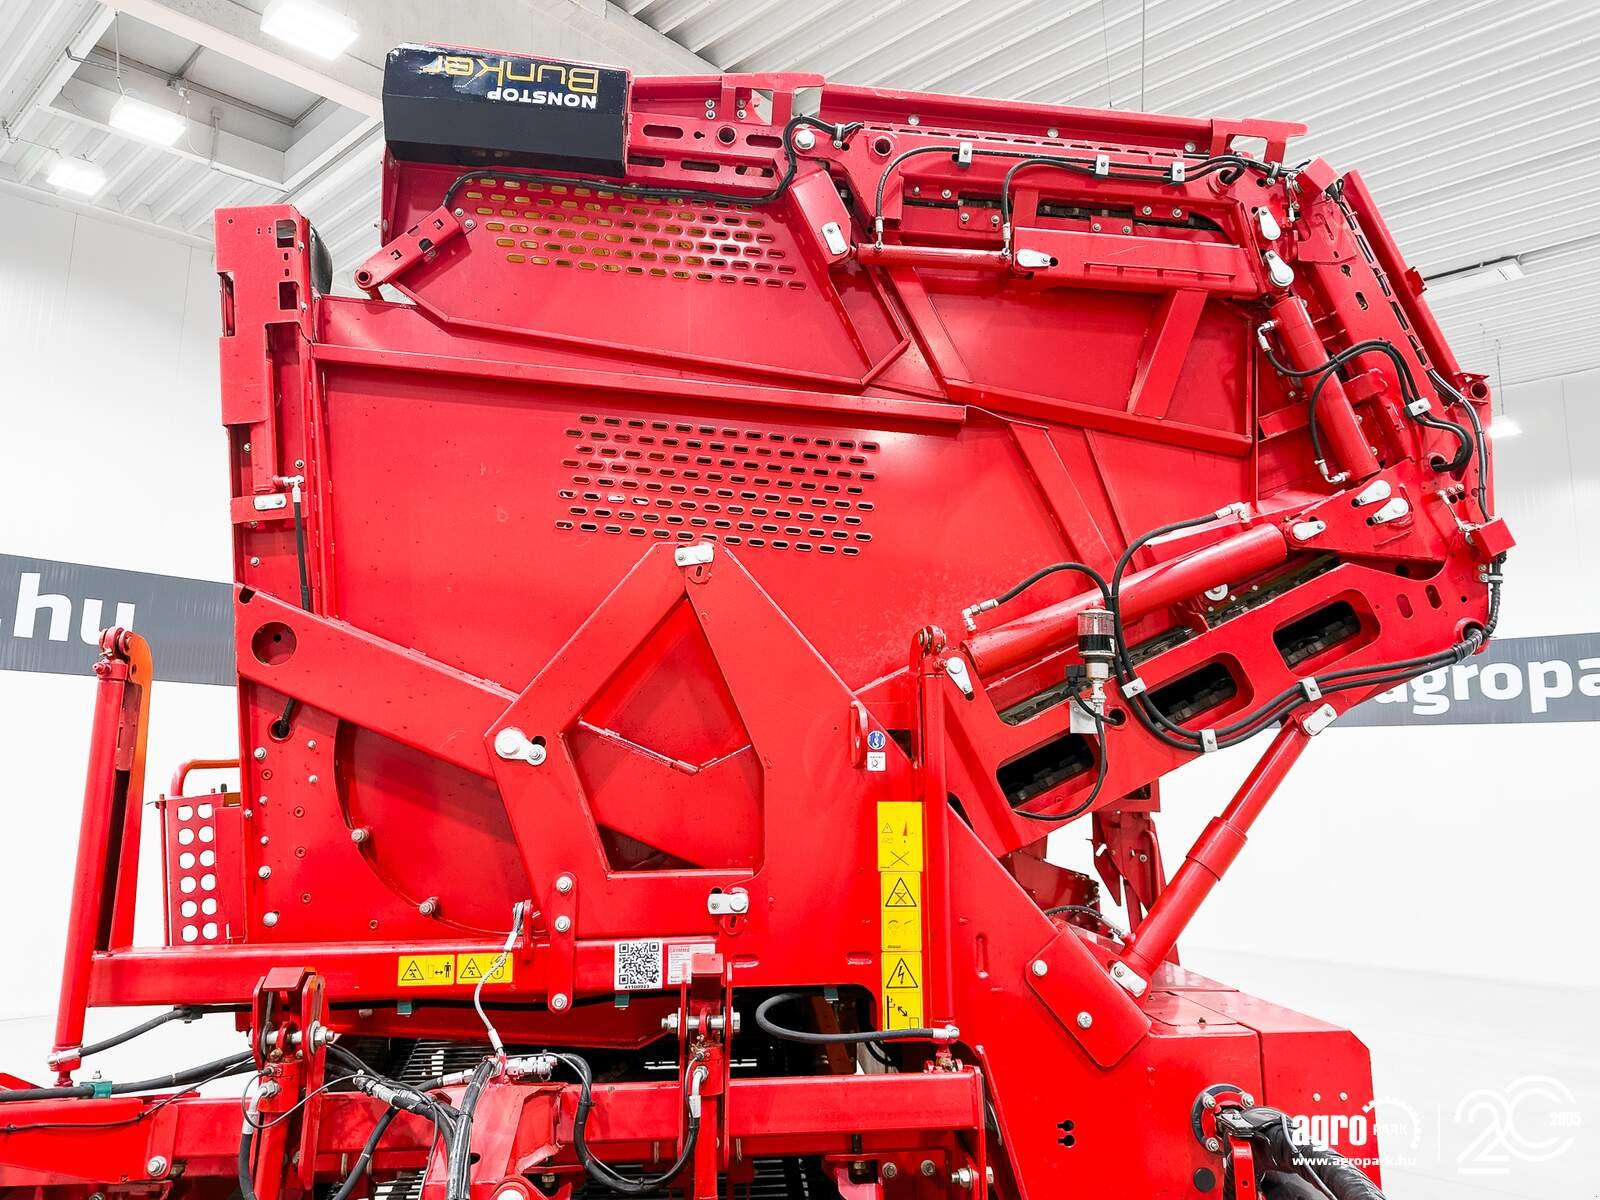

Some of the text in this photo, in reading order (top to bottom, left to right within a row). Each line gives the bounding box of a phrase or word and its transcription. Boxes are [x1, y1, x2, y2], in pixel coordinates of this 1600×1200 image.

[422, 55, 599, 94] Bunker
[487, 87, 597, 109] NONSTOP
[0, 572, 136, 645] hu
